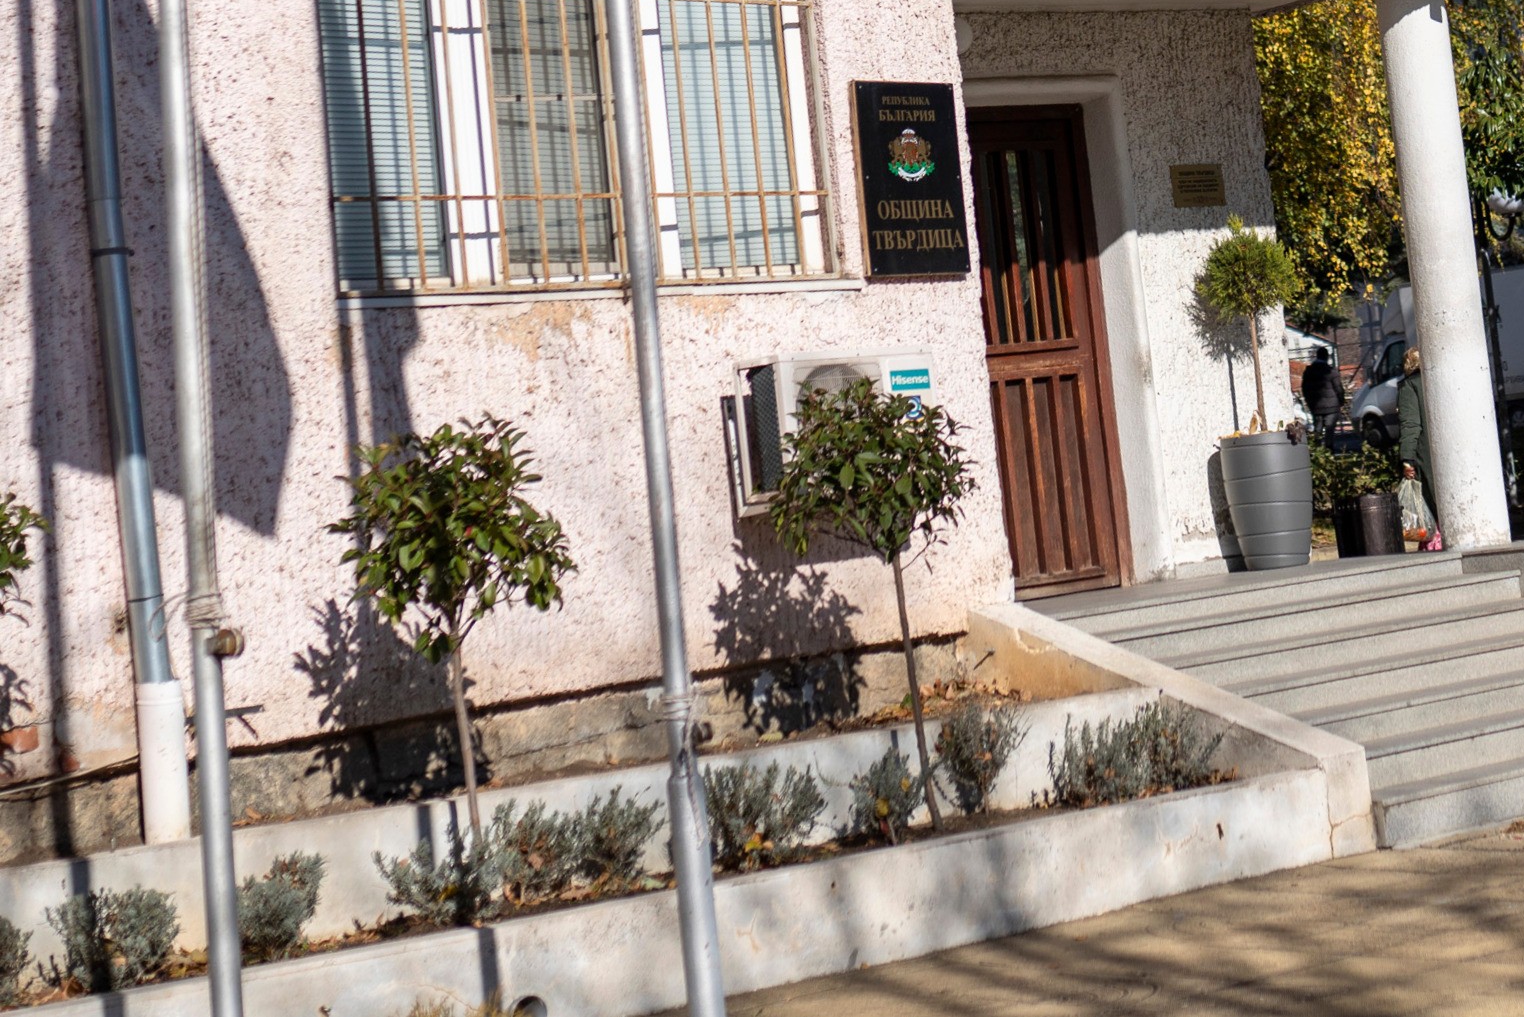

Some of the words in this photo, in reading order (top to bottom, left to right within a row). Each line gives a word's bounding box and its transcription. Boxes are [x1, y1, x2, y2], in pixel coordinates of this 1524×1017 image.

[881, 96, 930, 106] РЕПУБЛИКА
[878, 109, 936, 122] БЪЛГАРИЯ
[877, 199, 954, 221] ОБЩИНА
[872, 229, 965, 252] ТВЪРДИЦА
[891, 374, 929, 386] Hisense
